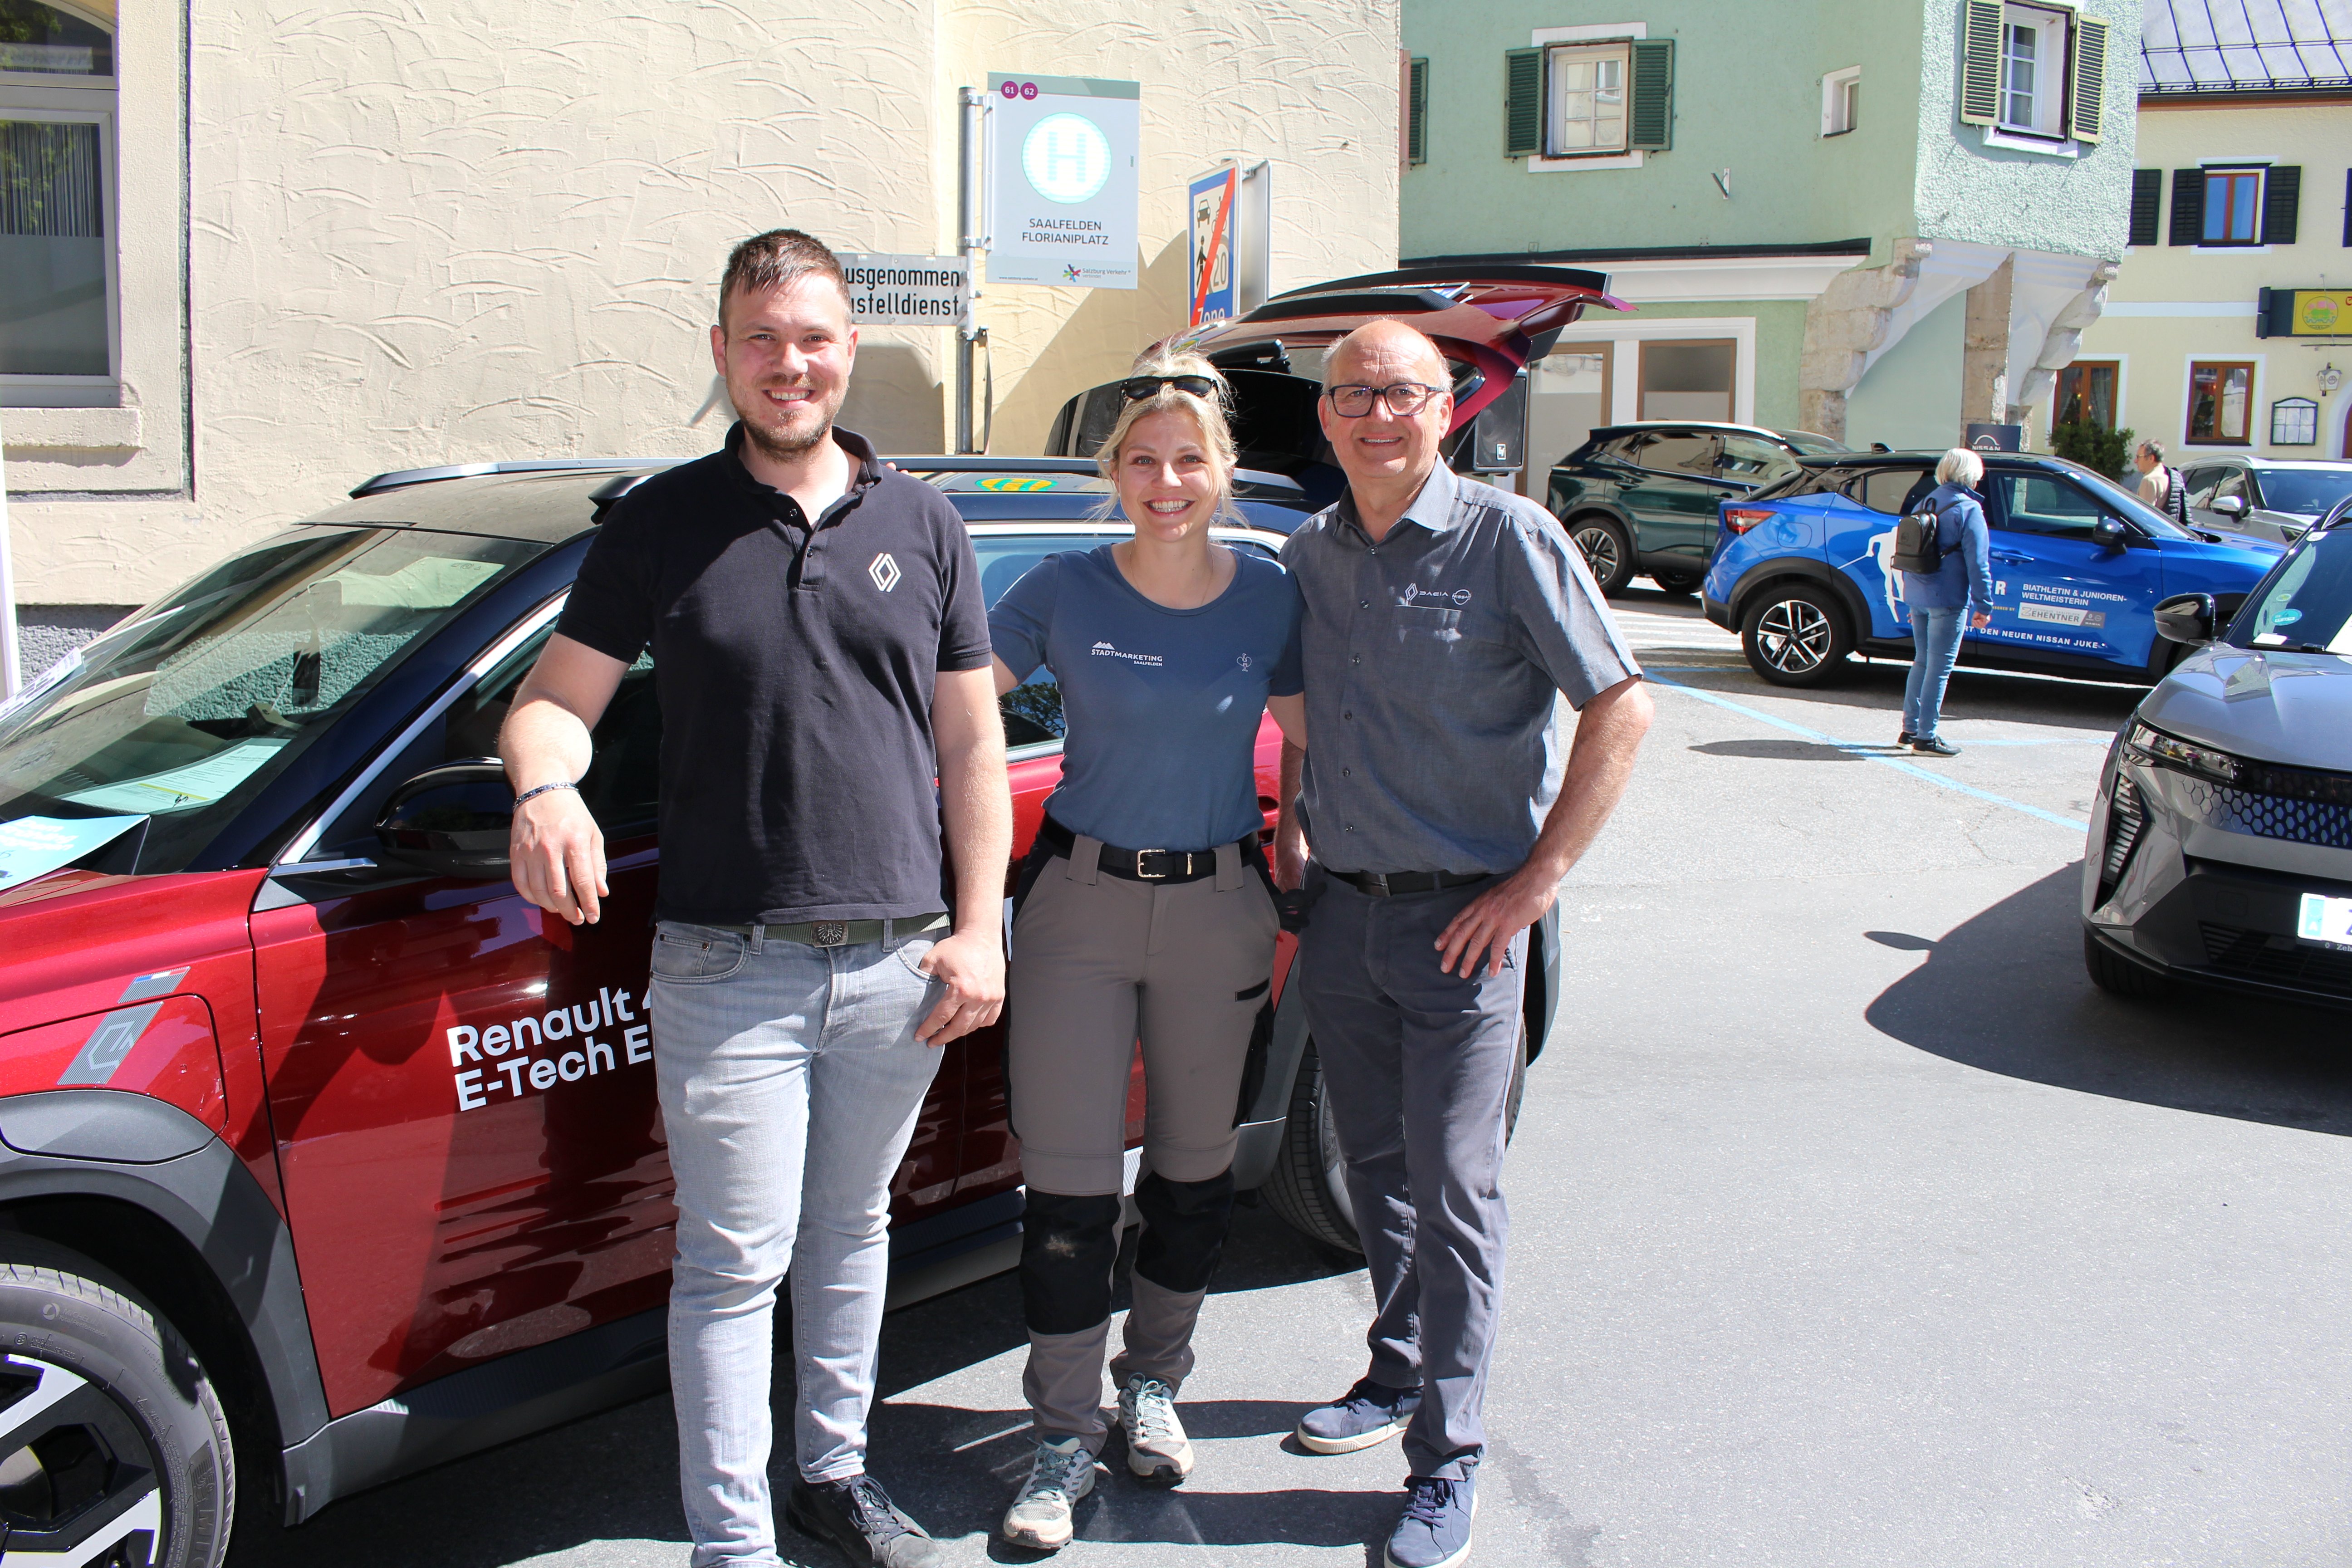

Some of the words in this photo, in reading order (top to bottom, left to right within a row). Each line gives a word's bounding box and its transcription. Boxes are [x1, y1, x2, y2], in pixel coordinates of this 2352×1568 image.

[1005, 86, 1015, 94] 61
[1024, 88, 1034, 96] 62
[1047, 131, 1087, 182] H
[1029, 218, 1102, 231] SAALFELDEN
[1022, 232, 1109, 245] FLORIANIPLATZ
[1213, 251, 1227, 287] 20
[2022, 592, 2089, 606] WELTMEISTERIN
[2023, 583, 2070, 595] BIATHLETIN
[2080, 591, 2127, 602] JUNIOREN-
[2021, 607, 2079, 622] ZEHENTNER
[1980, 627, 1999, 636] DEN
[2002, 630, 2033, 640] NEUEN
[2036, 635, 2070, 645] NISSAN
[2073, 640, 2098, 648] JUKE
[1091, 649, 1162, 662] STADTMARKETING
[446, 987, 634, 1067] Renault
[455, 1036, 615, 1111] E-Tech
[624, 1024, 652, 1064] E
[62, 1308, 99, 1326] MICHELIN
